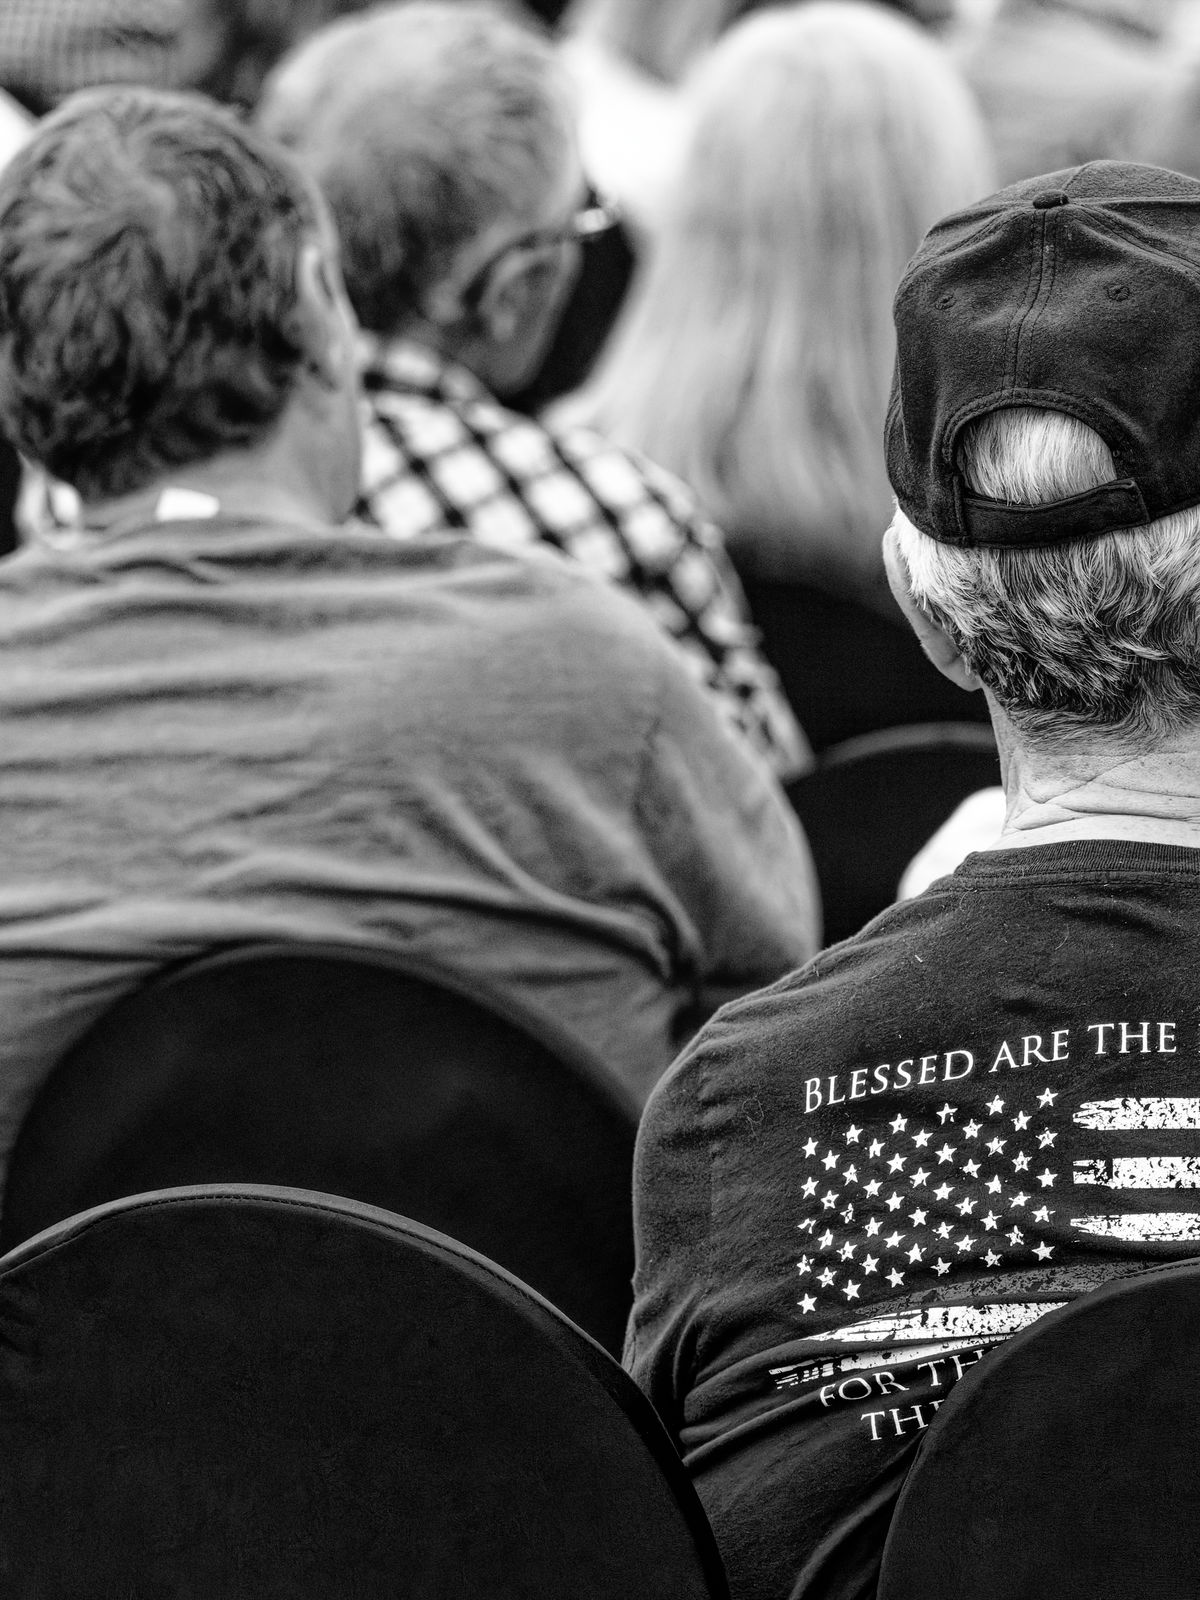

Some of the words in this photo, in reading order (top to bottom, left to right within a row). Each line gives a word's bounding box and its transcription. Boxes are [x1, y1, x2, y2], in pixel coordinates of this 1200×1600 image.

[803, 1049, 974, 1115] BLESSED
[988, 1029, 1070, 1073] ARE
[1086, 1022, 1177, 1055] THE
[818, 1371, 910, 1407] FOR
[917, 1347, 996, 1388] TH
